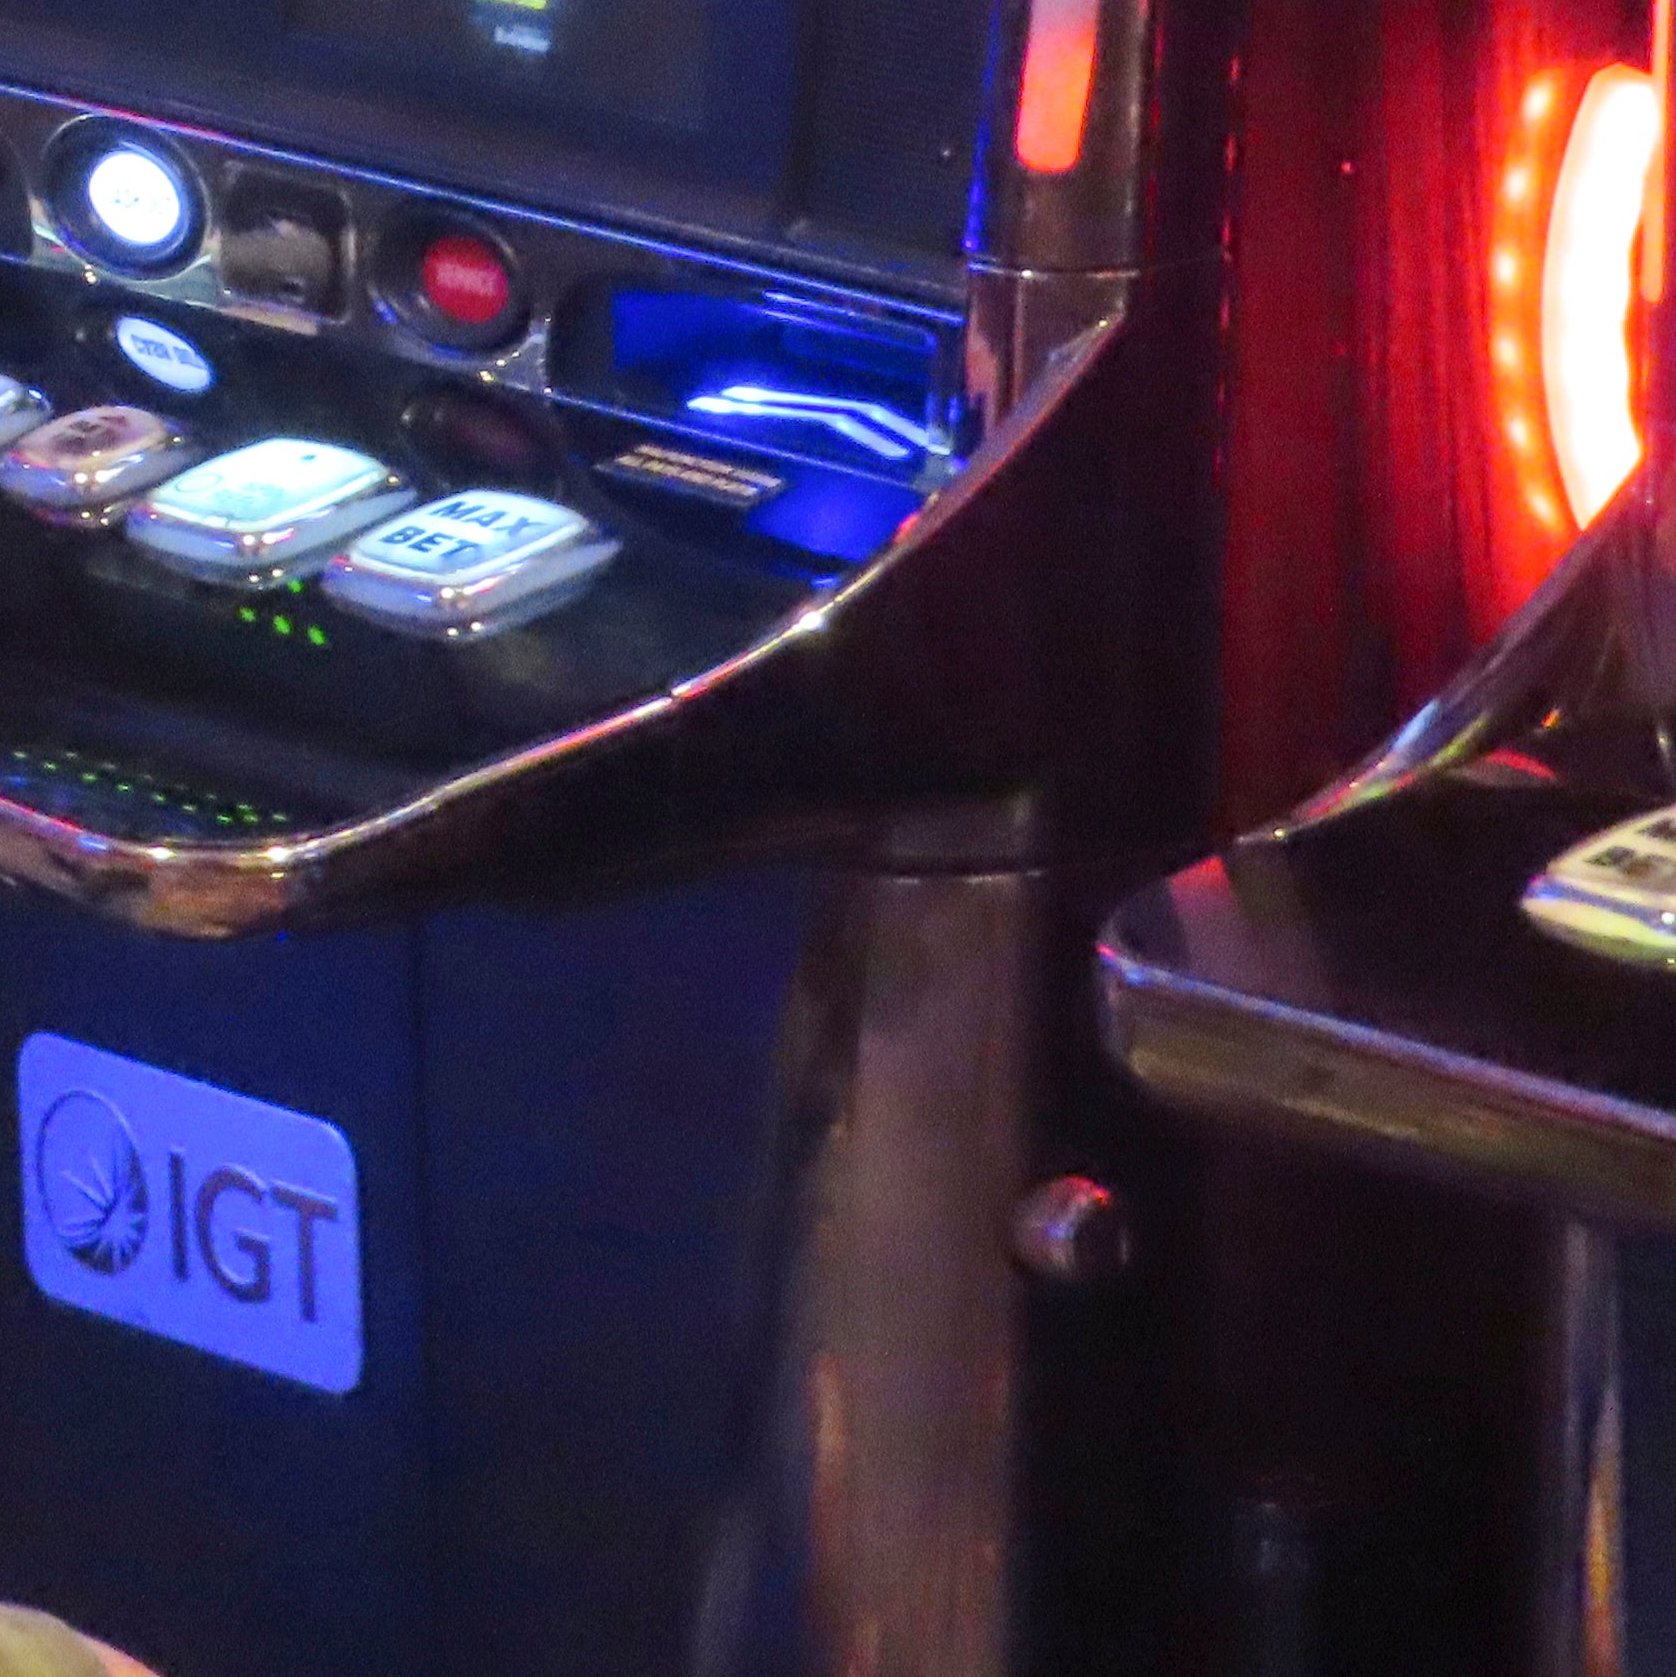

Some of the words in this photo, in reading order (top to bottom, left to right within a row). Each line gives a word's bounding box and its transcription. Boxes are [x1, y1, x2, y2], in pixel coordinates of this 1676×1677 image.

[434, 500, 545, 539] MAX
[378, 524, 480, 561] BET
[169, 1147, 340, 1324] IGT
